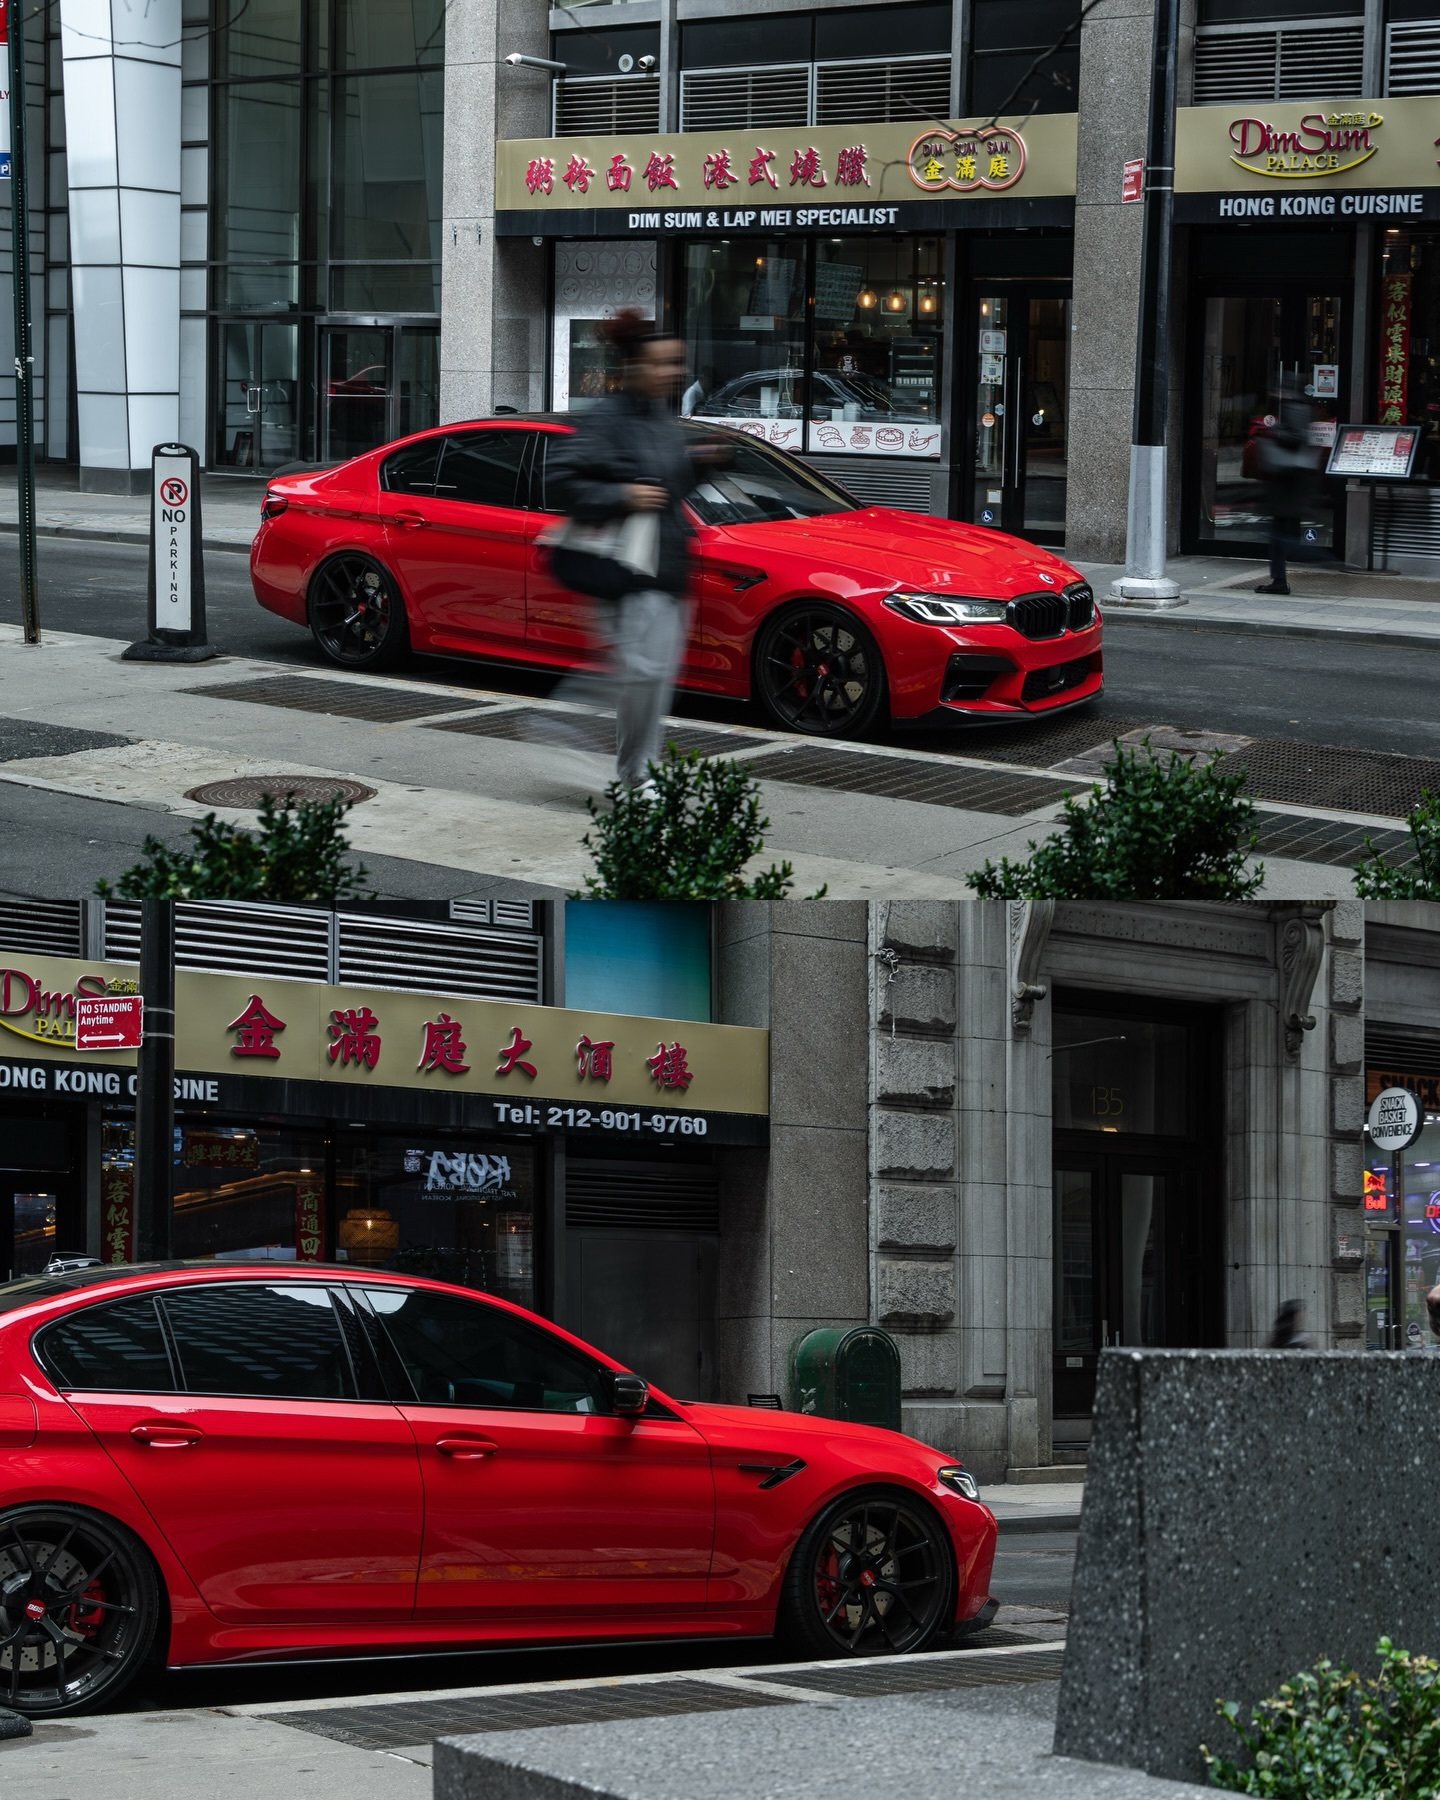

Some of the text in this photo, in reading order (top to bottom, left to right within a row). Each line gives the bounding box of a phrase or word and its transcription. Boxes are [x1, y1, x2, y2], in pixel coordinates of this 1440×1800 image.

[1266, 154, 1339, 171] PALACE
[1219, 194, 1423, 216] HONG KONG CUISINE
[629, 207, 899, 229] DIM SUM & LAP MEI SPECIALIST
[162, 509, 186, 523] NO
[170, 527, 178, 602] PARKING
[80, 1002, 133, 1014] NO STANDING
[80, 1015, 114, 1026] Anytime
[54, 1069, 120, 1094] KONG
[1380, 1095, 1406, 1111] SNACK
[493, 1102, 707, 1136] Tel: 212-901-9760
[1379, 1109, 1407, 1125] BASKET
[1372, 1123, 1413, 1139] CONVENIENCE
